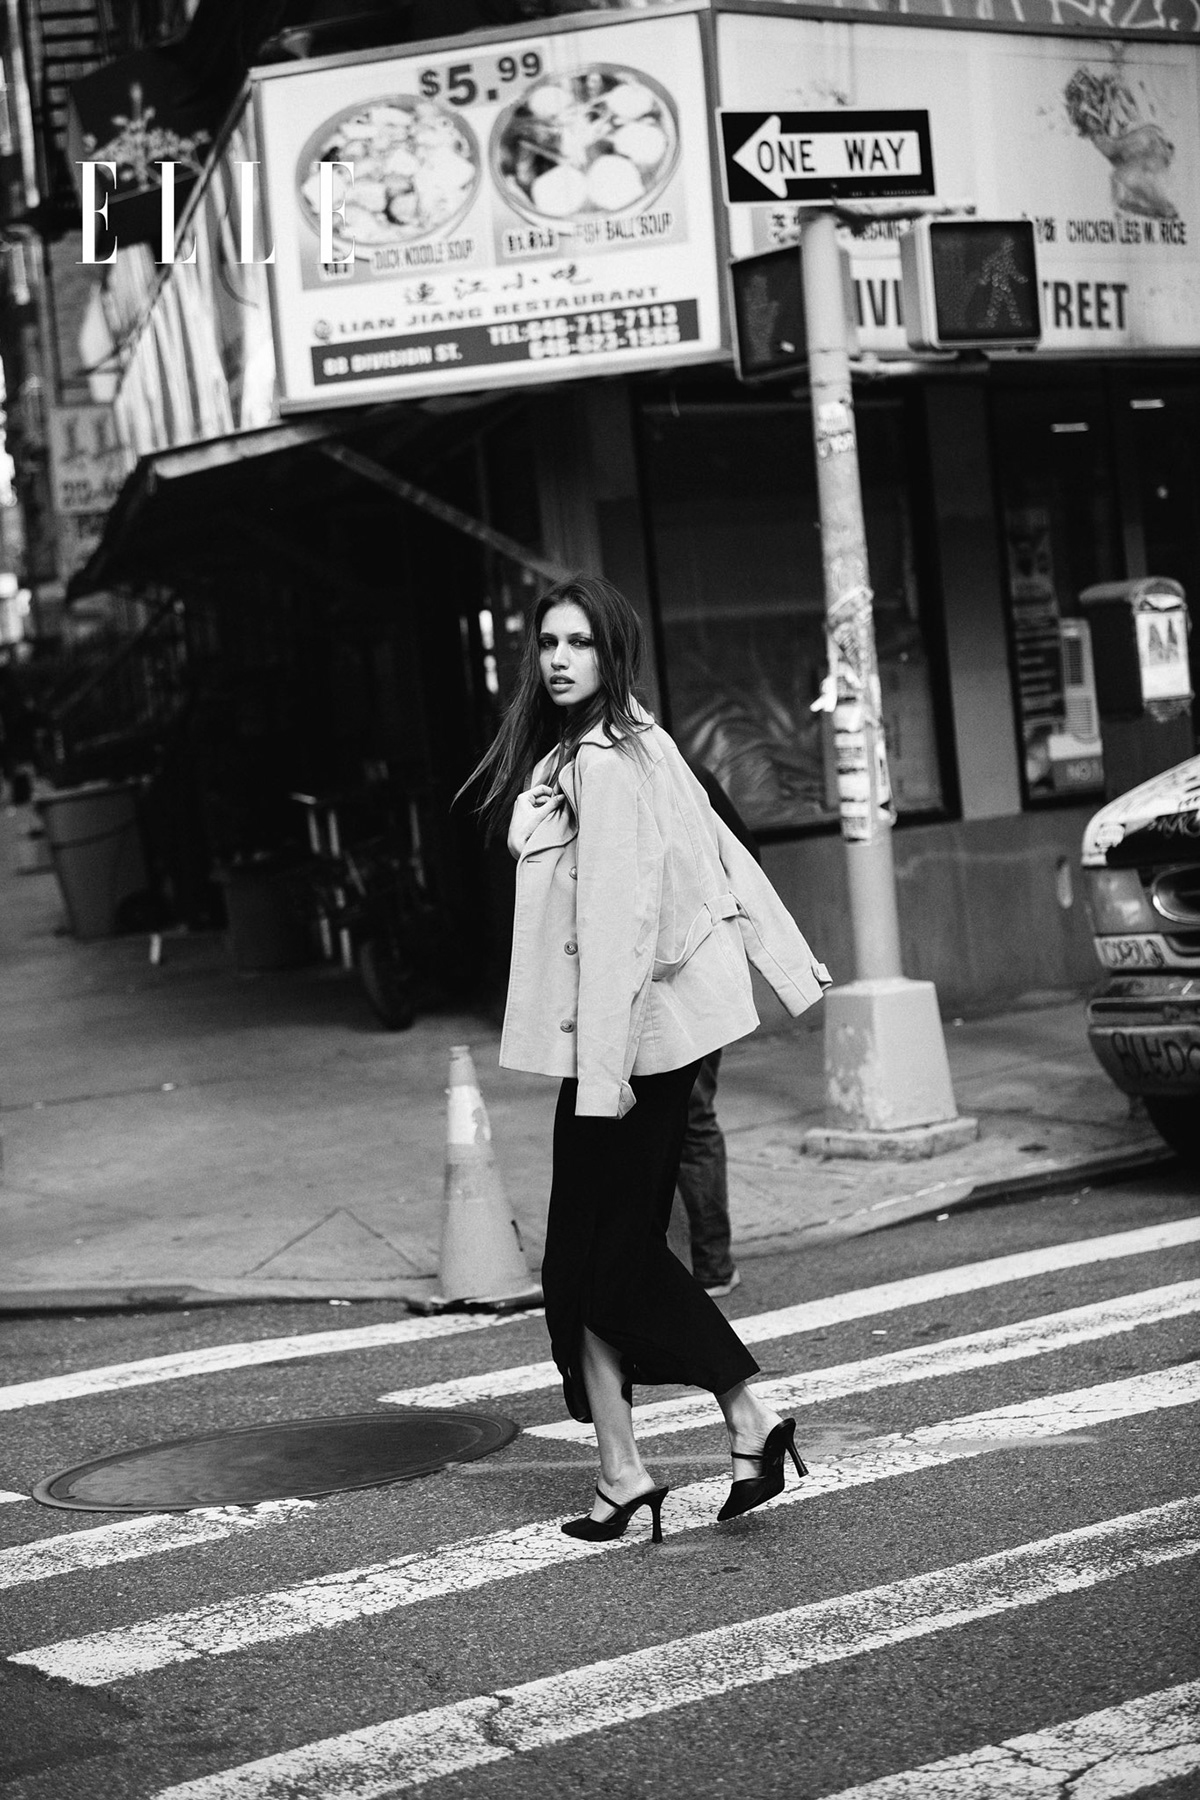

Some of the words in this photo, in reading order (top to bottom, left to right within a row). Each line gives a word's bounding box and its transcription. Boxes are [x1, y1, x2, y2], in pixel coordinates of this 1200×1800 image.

[421, 52, 541, 106] $5.99
[758, 140, 816, 173] ONE
[844, 138, 905, 171] WAY
[339, 318, 395, 334] LIAN
[408, 307, 482, 326] JIANG
[493, 286, 658, 316] RESTAURANT
